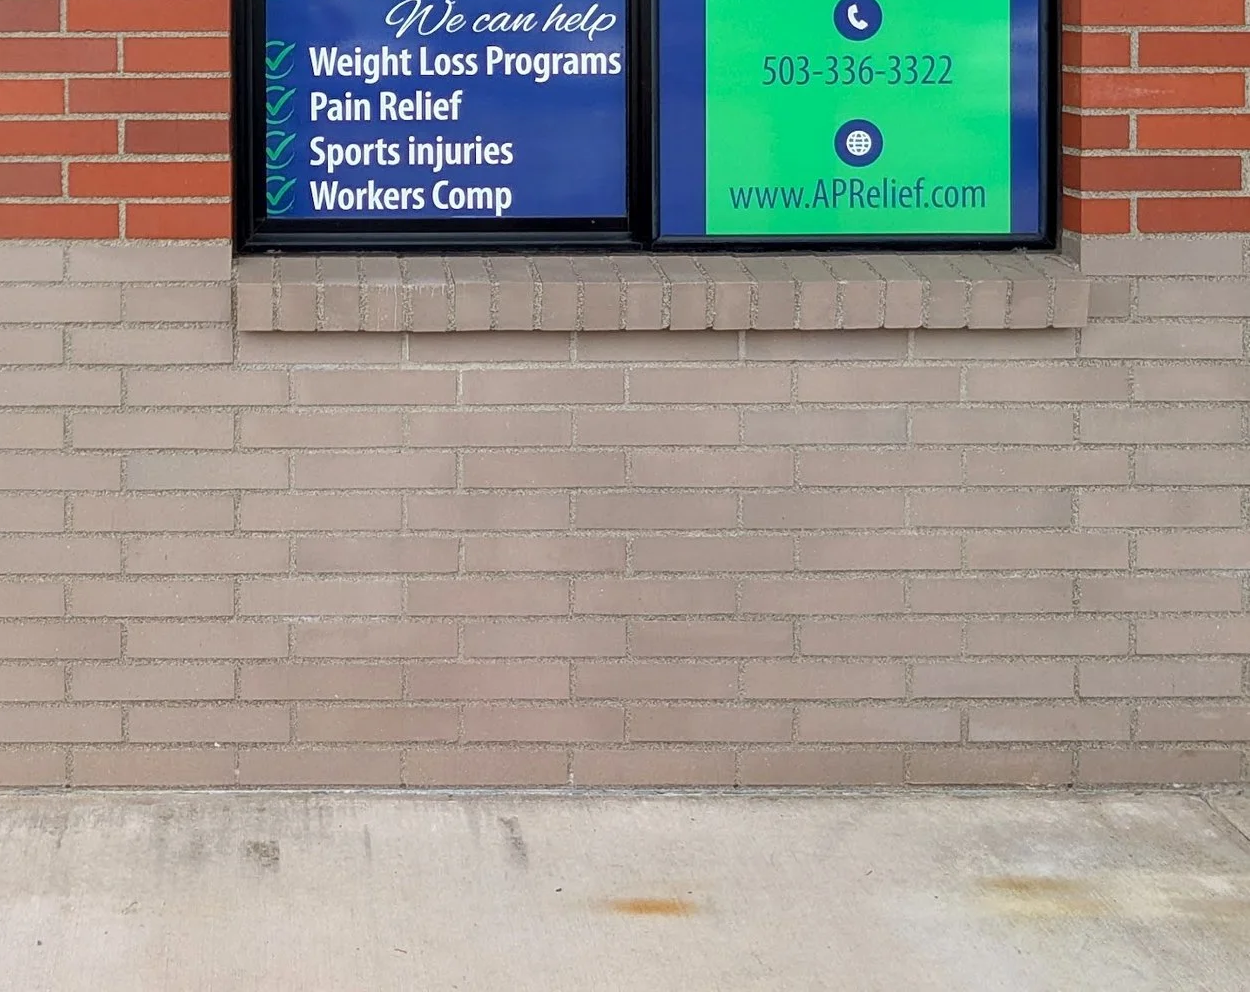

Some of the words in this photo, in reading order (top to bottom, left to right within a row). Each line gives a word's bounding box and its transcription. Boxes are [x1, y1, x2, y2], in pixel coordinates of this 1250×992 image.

[472, 10, 540, 33] can
[542, 2, 617, 41] help
[309, 46, 412, 84] Weight
[420, 46, 478, 76] Loss
[486, 45, 622, 83] Programs
[762, 55, 954, 85] 503-336-3322
[310, 90, 371, 122] Pain
[379, 89, 463, 122] Relief
[309, 136, 400, 173] Sports
[407, 135, 514, 172] injuries
[310, 180, 425, 211] Workers
[432, 179, 512, 217] Comp
[729, 176, 987, 210] www.APRelief.com
